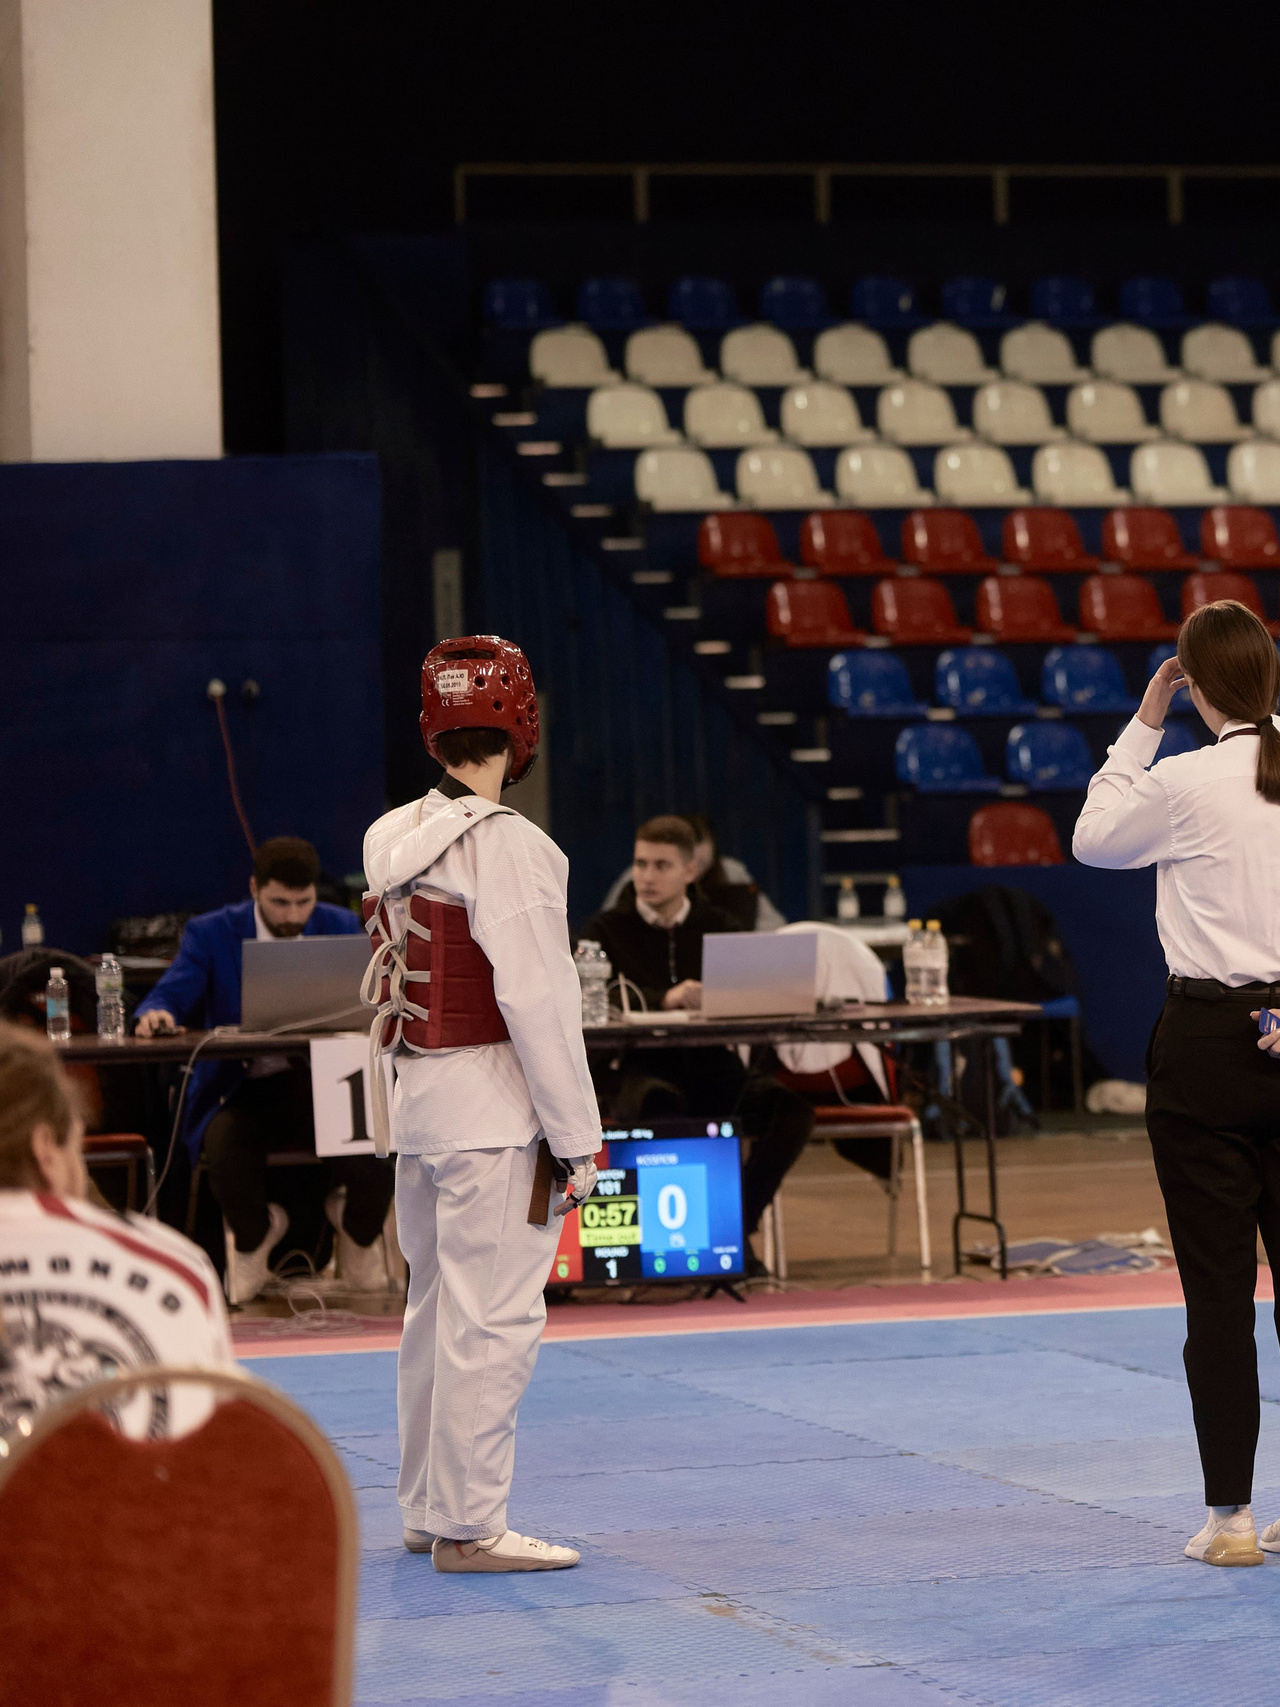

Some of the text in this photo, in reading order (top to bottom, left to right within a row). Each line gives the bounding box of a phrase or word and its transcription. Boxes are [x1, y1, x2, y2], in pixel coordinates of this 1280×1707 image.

[336, 1067, 375, 1144] 1
[597, 1181, 622, 1195] 101
[583, 1202, 637, 1228] 0:57
[658, 1184, 687, 1230] 0
[594, 1246, 629, 1258] ROUND
[605, 1259, 617, 1279] 1
